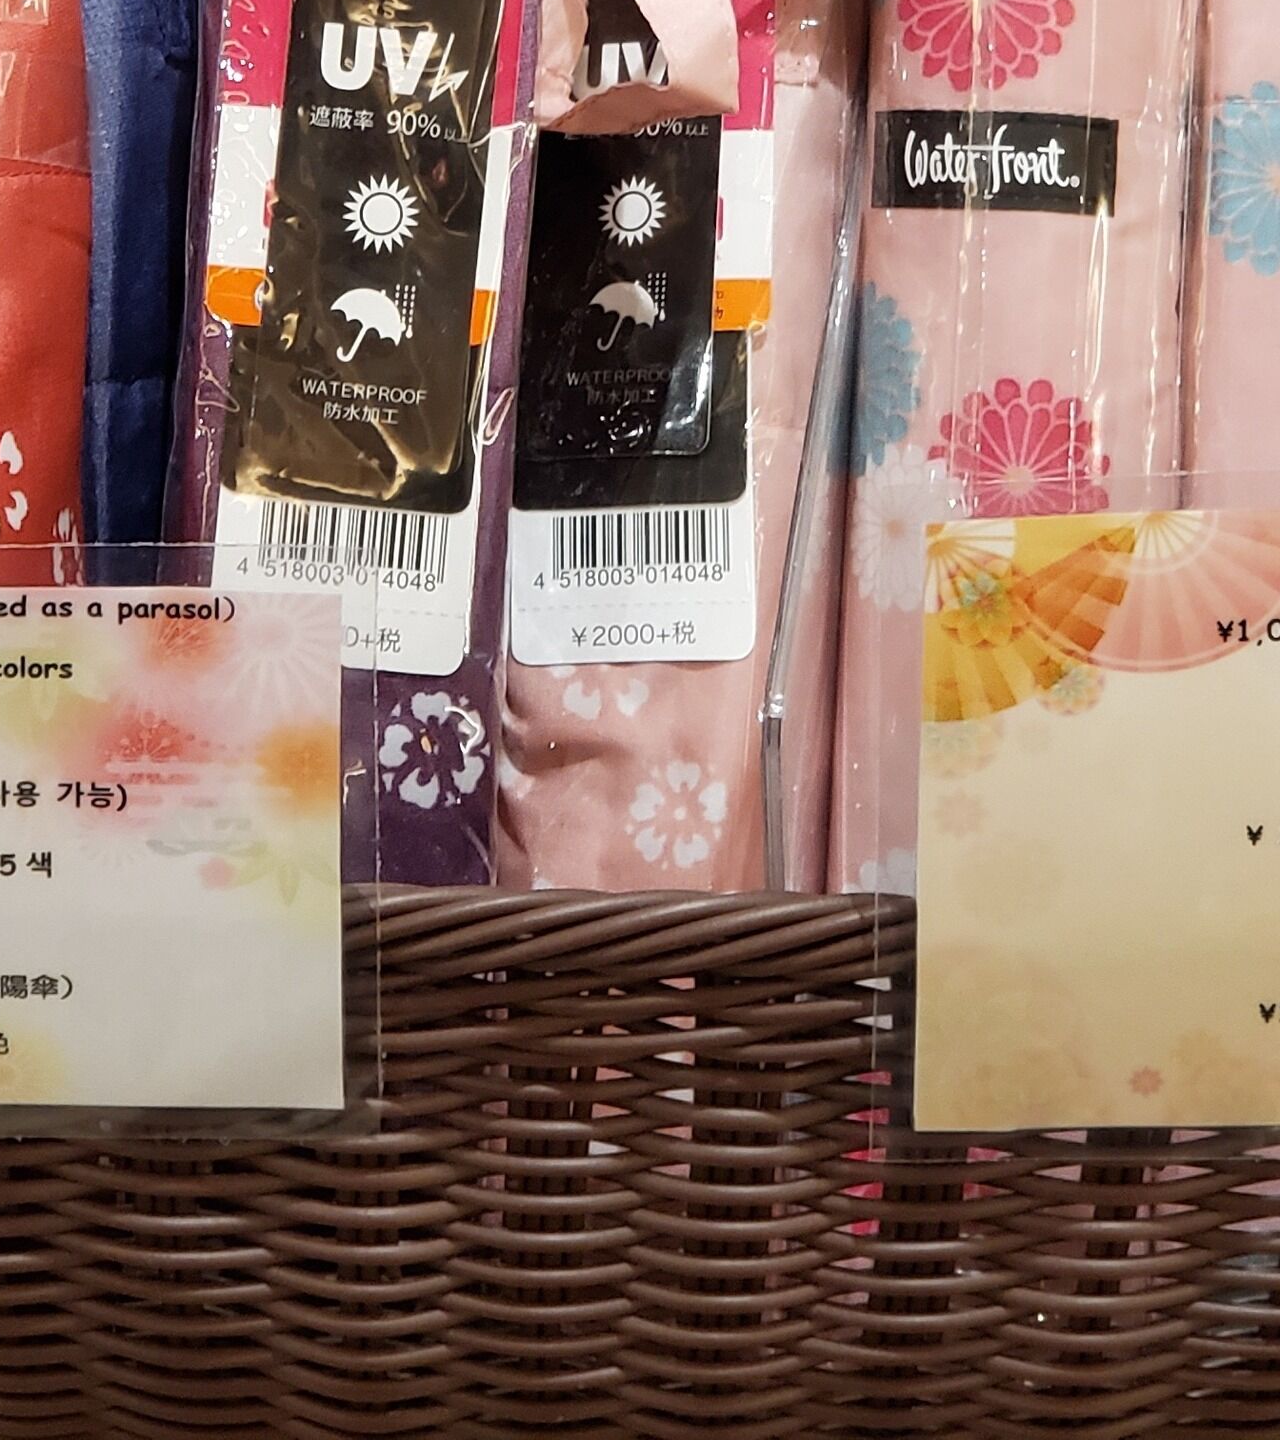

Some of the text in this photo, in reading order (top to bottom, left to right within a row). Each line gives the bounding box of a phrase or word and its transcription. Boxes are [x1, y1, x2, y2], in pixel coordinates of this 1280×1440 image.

[320, 21, 439, 96] UV
[904, 129, 982, 189] Water
[302, 377, 428, 406] WATERPROOF
[323, 400, 400, 425] 防水加工
[236, 556, 249, 576] 4
[263, 558, 346, 587] 518003
[533, 563, 724, 590] 4 518003 014048
[41, 600, 73, 618] as
[87, 600, 103, 619] a
[118, 596, 236, 625] parasol)
[571, 620, 697, 648] ¥2000+税
[56, 780, 129, 812] 가능)
